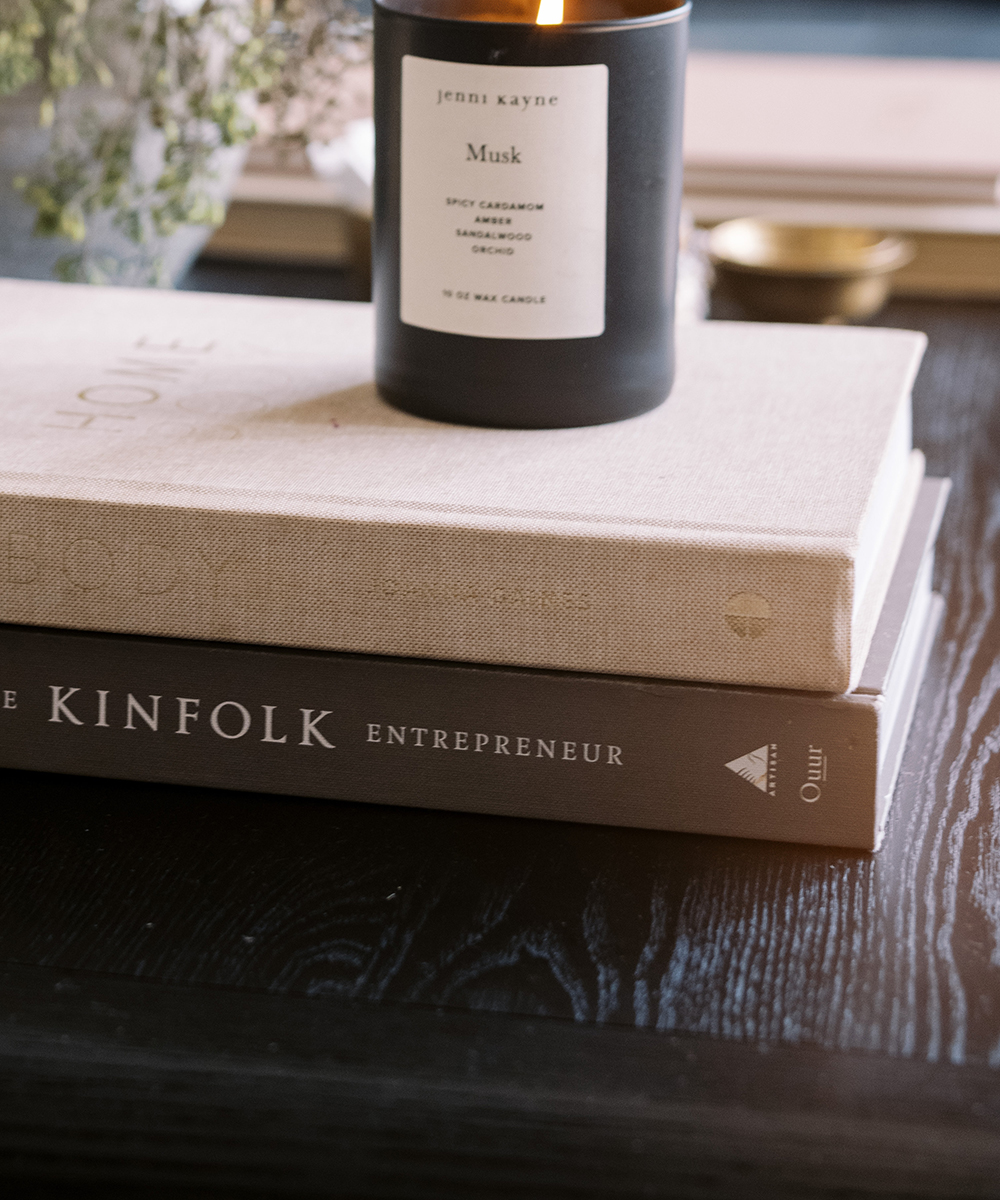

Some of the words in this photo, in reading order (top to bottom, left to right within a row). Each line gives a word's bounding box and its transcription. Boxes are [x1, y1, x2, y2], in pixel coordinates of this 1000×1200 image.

[436, 88, 488, 105] jenni
[465, 142, 522, 165] Musk
[446, 197, 475, 208] SPICY
[478, 200, 544, 211] CARDAMOM
[474, 215, 512, 225] AMBER
[455, 228, 532, 241] SANDALWOOD
[471, 244, 514, 256] ORCHID
[473, 293, 498, 302] WAX
[501, 295, 546, 304] CANDLE
[47, 685, 337, 750] KINFOLK
[365, 722, 625, 766] ENTREPRENEUR
[768, 743, 778, 798] ARTISAN
